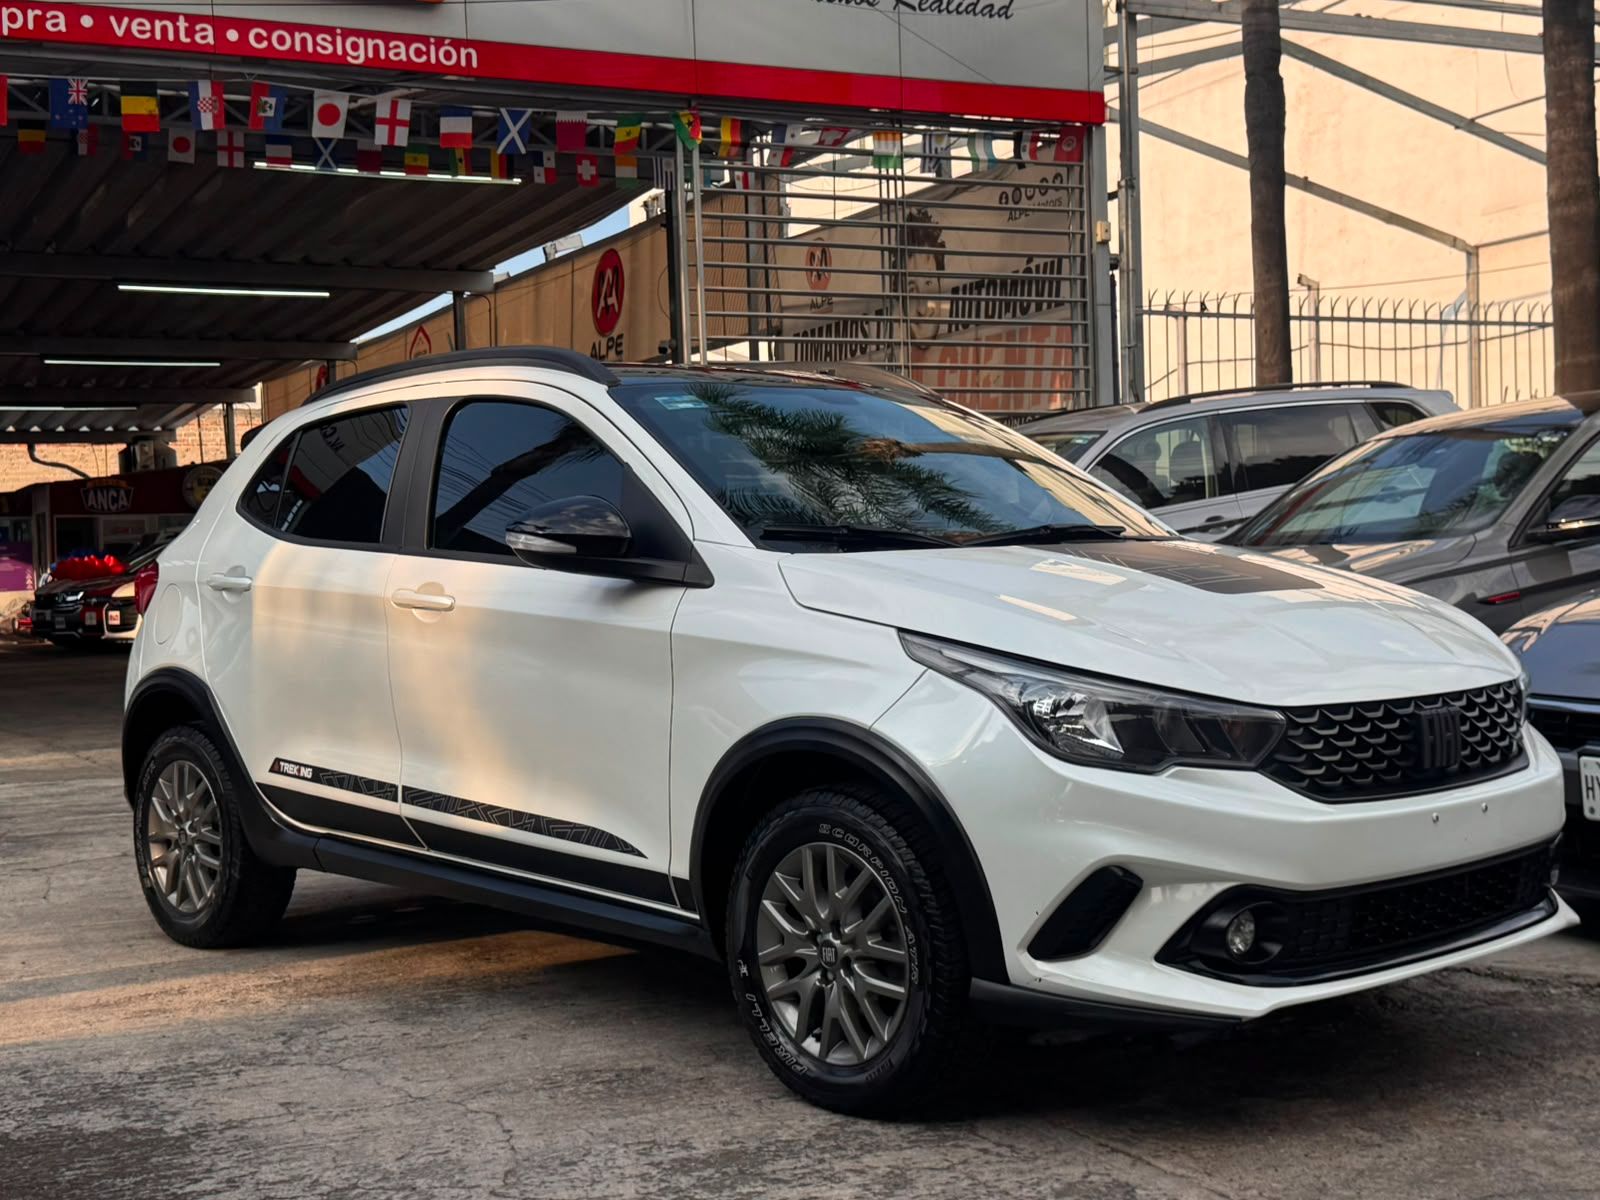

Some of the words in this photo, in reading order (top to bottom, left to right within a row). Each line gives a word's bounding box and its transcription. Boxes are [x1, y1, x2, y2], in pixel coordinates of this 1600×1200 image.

[1, 6, 67, 36] pra
[109, 14, 215, 46] venta
[247, 26, 479, 69] consignación
[590, 333, 624, 360] ALPE
[87, 488, 129, 512] ANCA
[818, 822, 908, 915] SCORPION
[745, 992, 808, 1075] PIRELLI
